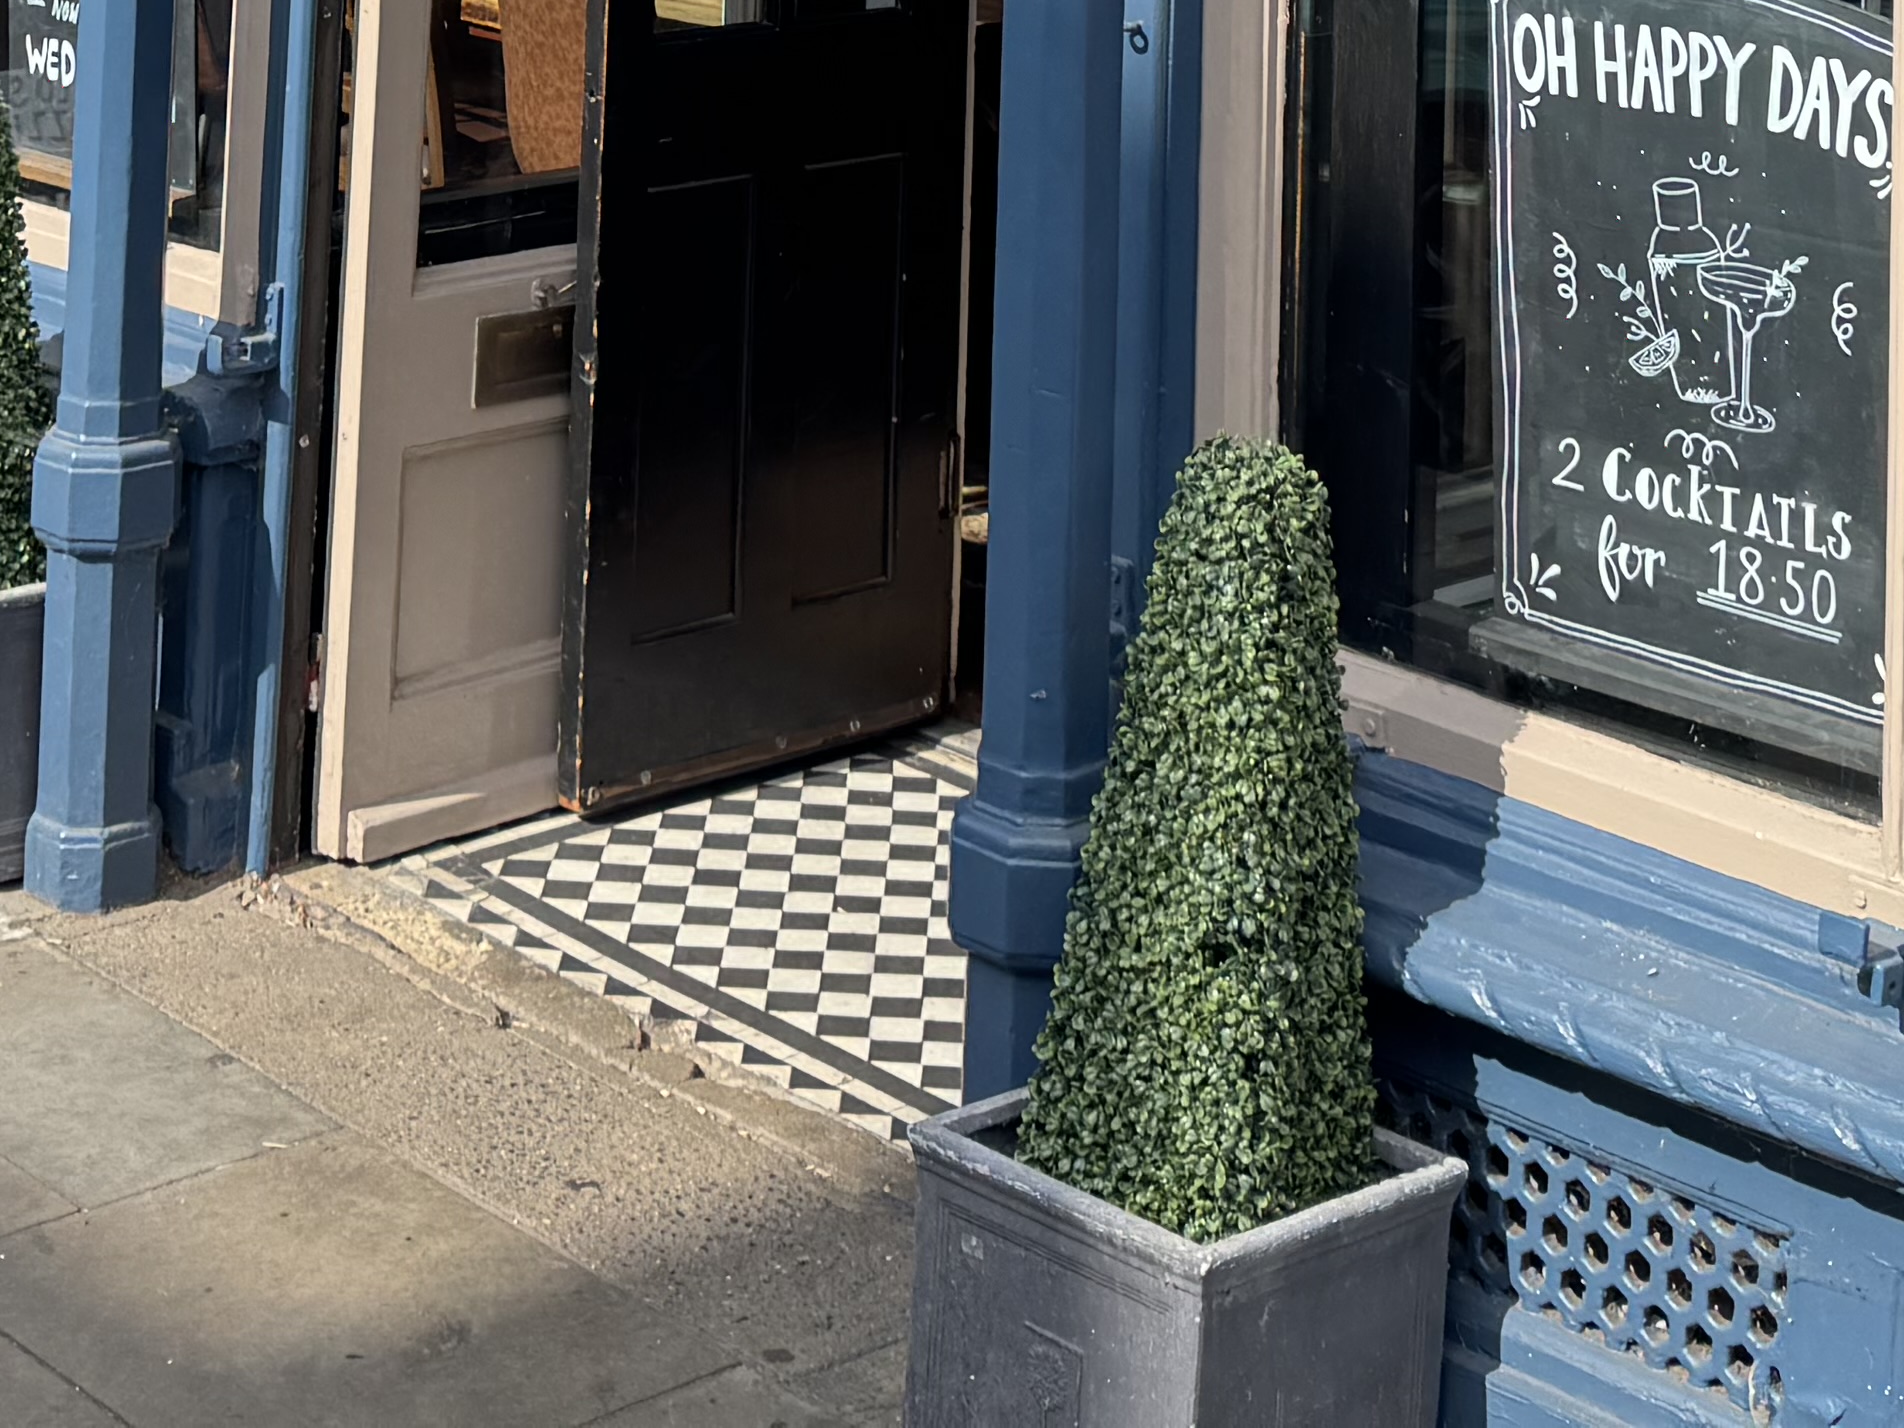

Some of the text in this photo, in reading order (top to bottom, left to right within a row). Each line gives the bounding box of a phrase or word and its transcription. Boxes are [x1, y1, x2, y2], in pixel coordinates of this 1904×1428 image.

[25, 33, 77, 89] WED
[1511, 12, 1579, 103] OH
[1593, 22, 1758, 127] HAPPY
[1552, 437, 1854, 563] 2 COCKTAILS
[1596, 514, 1667, 603] for
